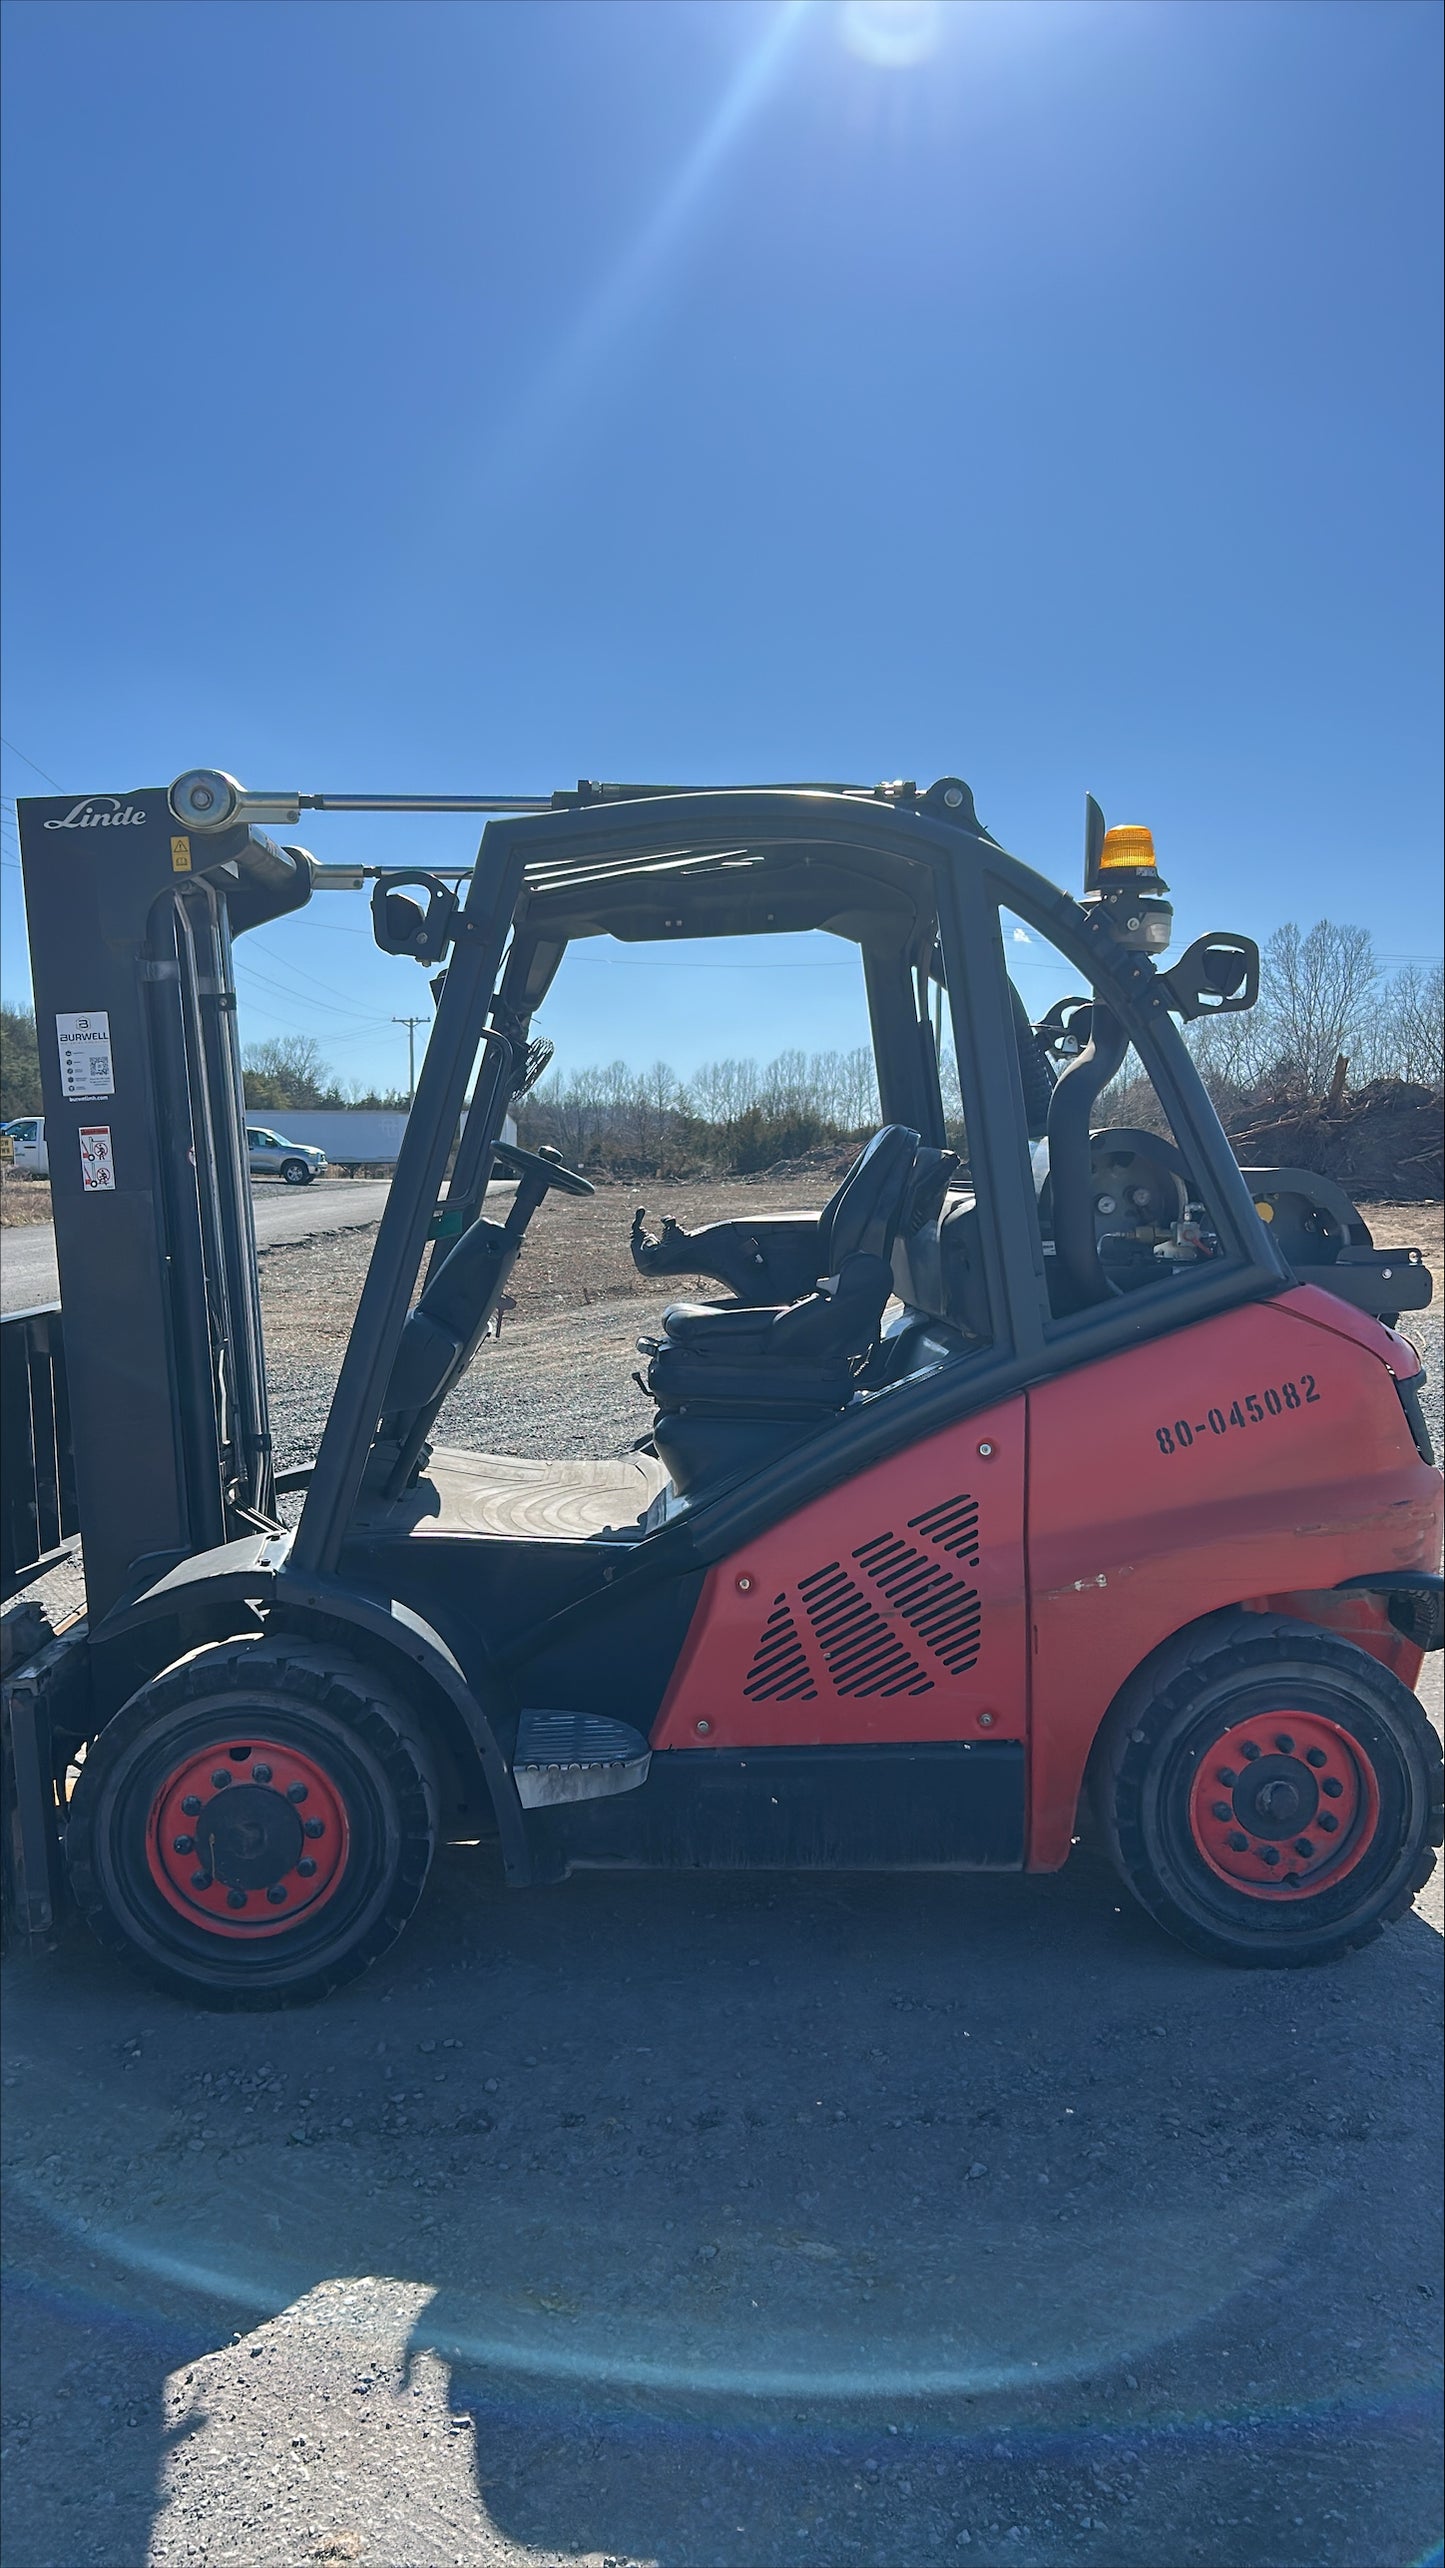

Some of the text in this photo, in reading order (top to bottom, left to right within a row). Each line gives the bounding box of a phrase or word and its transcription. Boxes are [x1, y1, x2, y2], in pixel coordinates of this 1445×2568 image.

[44, 797, 147, 830] Linde
[59, 1032, 109, 1042] BURWELL
[1155, 1374, 1321, 1455] 80-045082
